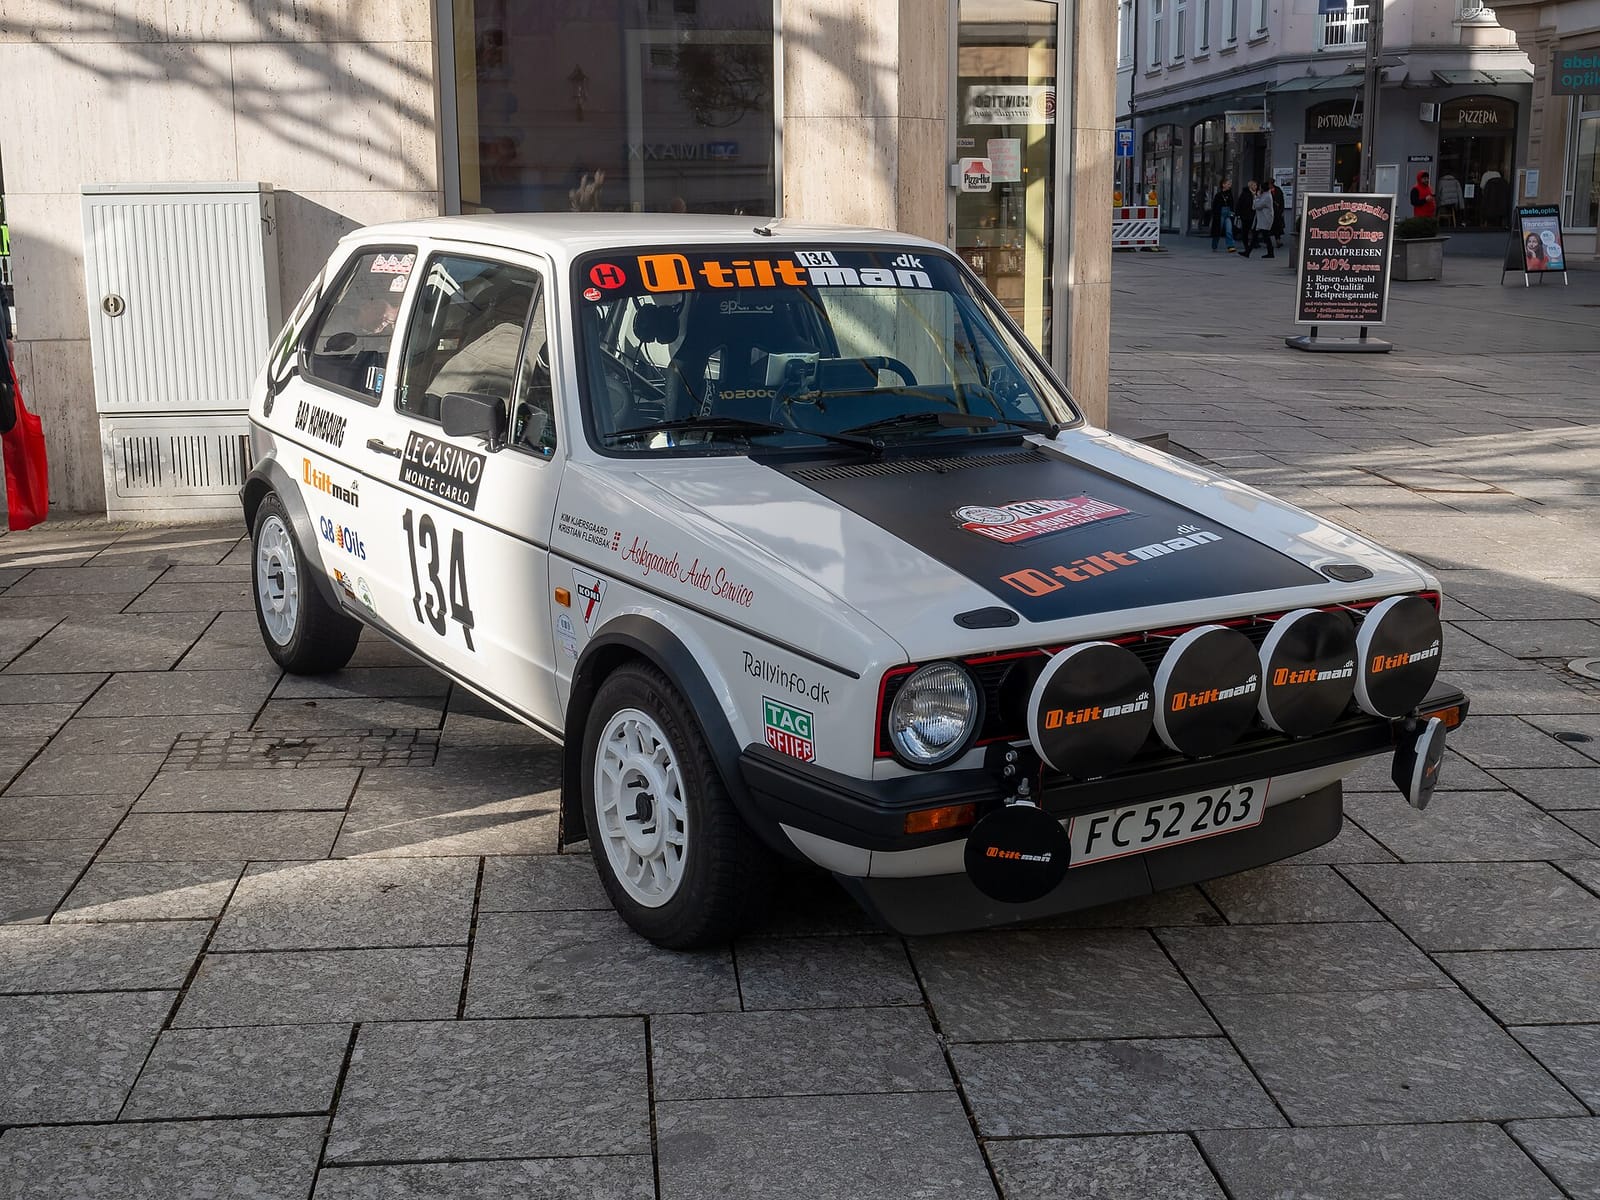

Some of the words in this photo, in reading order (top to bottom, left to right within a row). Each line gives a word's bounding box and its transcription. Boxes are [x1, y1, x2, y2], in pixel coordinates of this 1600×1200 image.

[1308, 200, 1389, 221] Trauringstudio
[800, 253, 833, 266] 134
[1309, 248, 1382, 257] TRAUMPREISEN
[699, 260, 933, 288] tiltman
[891, 253, 924, 269] .dk
[1307, 262, 1320, 271] bis
[1321, 259, 1350, 271] 20%
[1352, 264, 1381, 273] sparen
[1314, 283, 1364, 292] Top-Qualität
[1315, 275, 1375, 283] Riesen-Auswahl
[1314, 291, 1379, 300] Bestpreisgarantie
[295, 400, 309, 431] BAD
[308, 405, 347, 448] HOMBOURG
[422, 441, 481, 485] CASINO
[312, 468, 359, 508] tiltman
[560, 512, 571, 523] KIM
[1008, 501, 1049, 518] 134
[320, 515, 335, 544] Q8
[344, 527, 366, 561] Oils
[558, 524, 581, 539] KRISTIAN
[581, 530, 611, 549] FLENSBAK
[1050, 531, 1224, 583] tiltman
[1176, 524, 1201, 535] .dk
[402, 507, 476, 653] 134
[679, 558, 712, 591] Auto
[711, 567, 754, 608] Service
[578, 584, 600, 602] KONI
[1385, 646, 1439, 670] tiltman
[742, 650, 830, 705] Rallyinfo.dk
[1289, 667, 1353, 684] tiltman
[1188, 681, 1257, 707] tiltman
[1245, 674, 1258, 684] .dk
[767, 704, 809, 737] TAG
[1065, 699, 1149, 725] tiltman
[1135, 691, 1149, 701] .dk
[1085, 810, 1136, 855] FC
[1140, 801, 1186, 842] 52
[1190, 786, 1255, 833] 263
[998, 850, 1051, 863] tiltman
